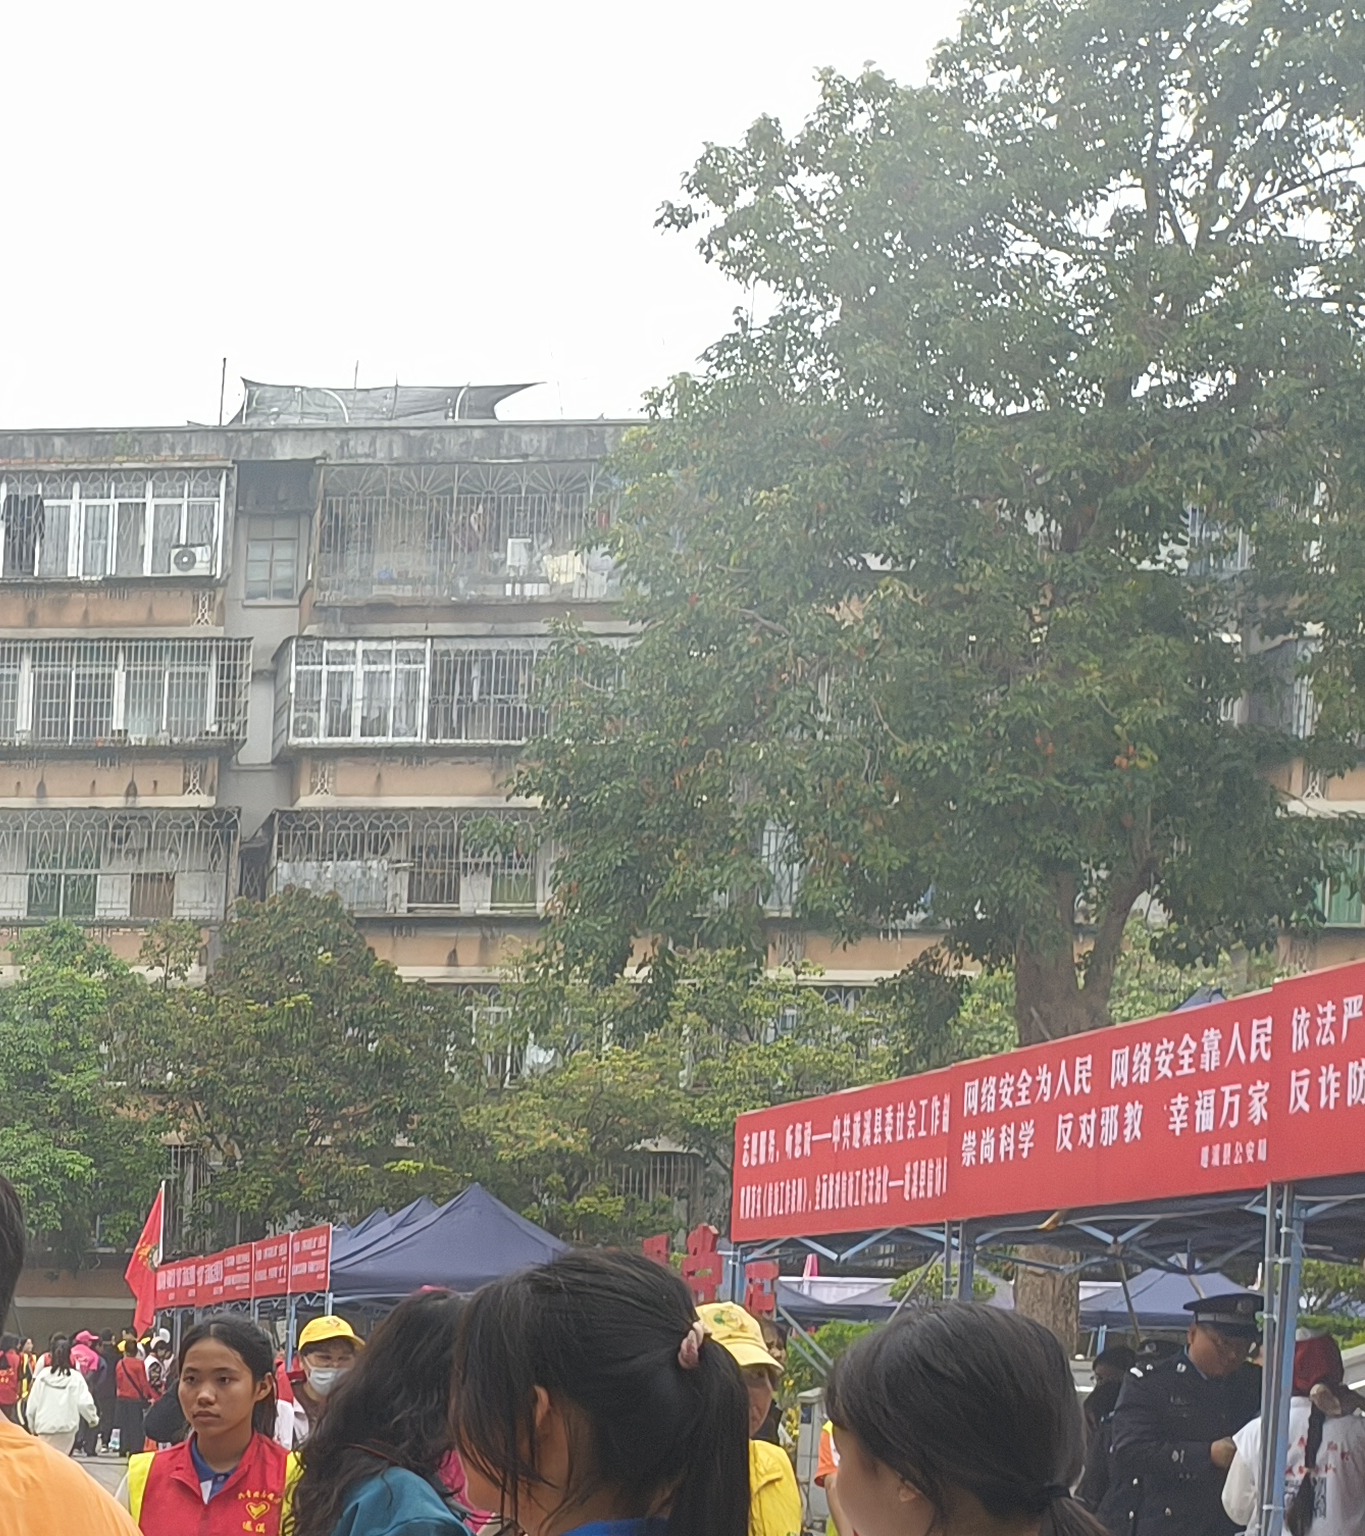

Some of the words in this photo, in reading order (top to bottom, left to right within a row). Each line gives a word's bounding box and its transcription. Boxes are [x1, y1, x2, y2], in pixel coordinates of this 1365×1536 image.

[963, 1054, 1093, 1117] 网络安全为人民
[1110, 1015, 1273, 1089] 网络安全靠人民
[1291, 994, 1364, 1053] 依法严
[961, 1119, 1035, 1167] 崇尚科学
[1056, 1100, 1144, 1152] 反对邪教
[1169, 1080, 1270, 1136] 幸福万家
